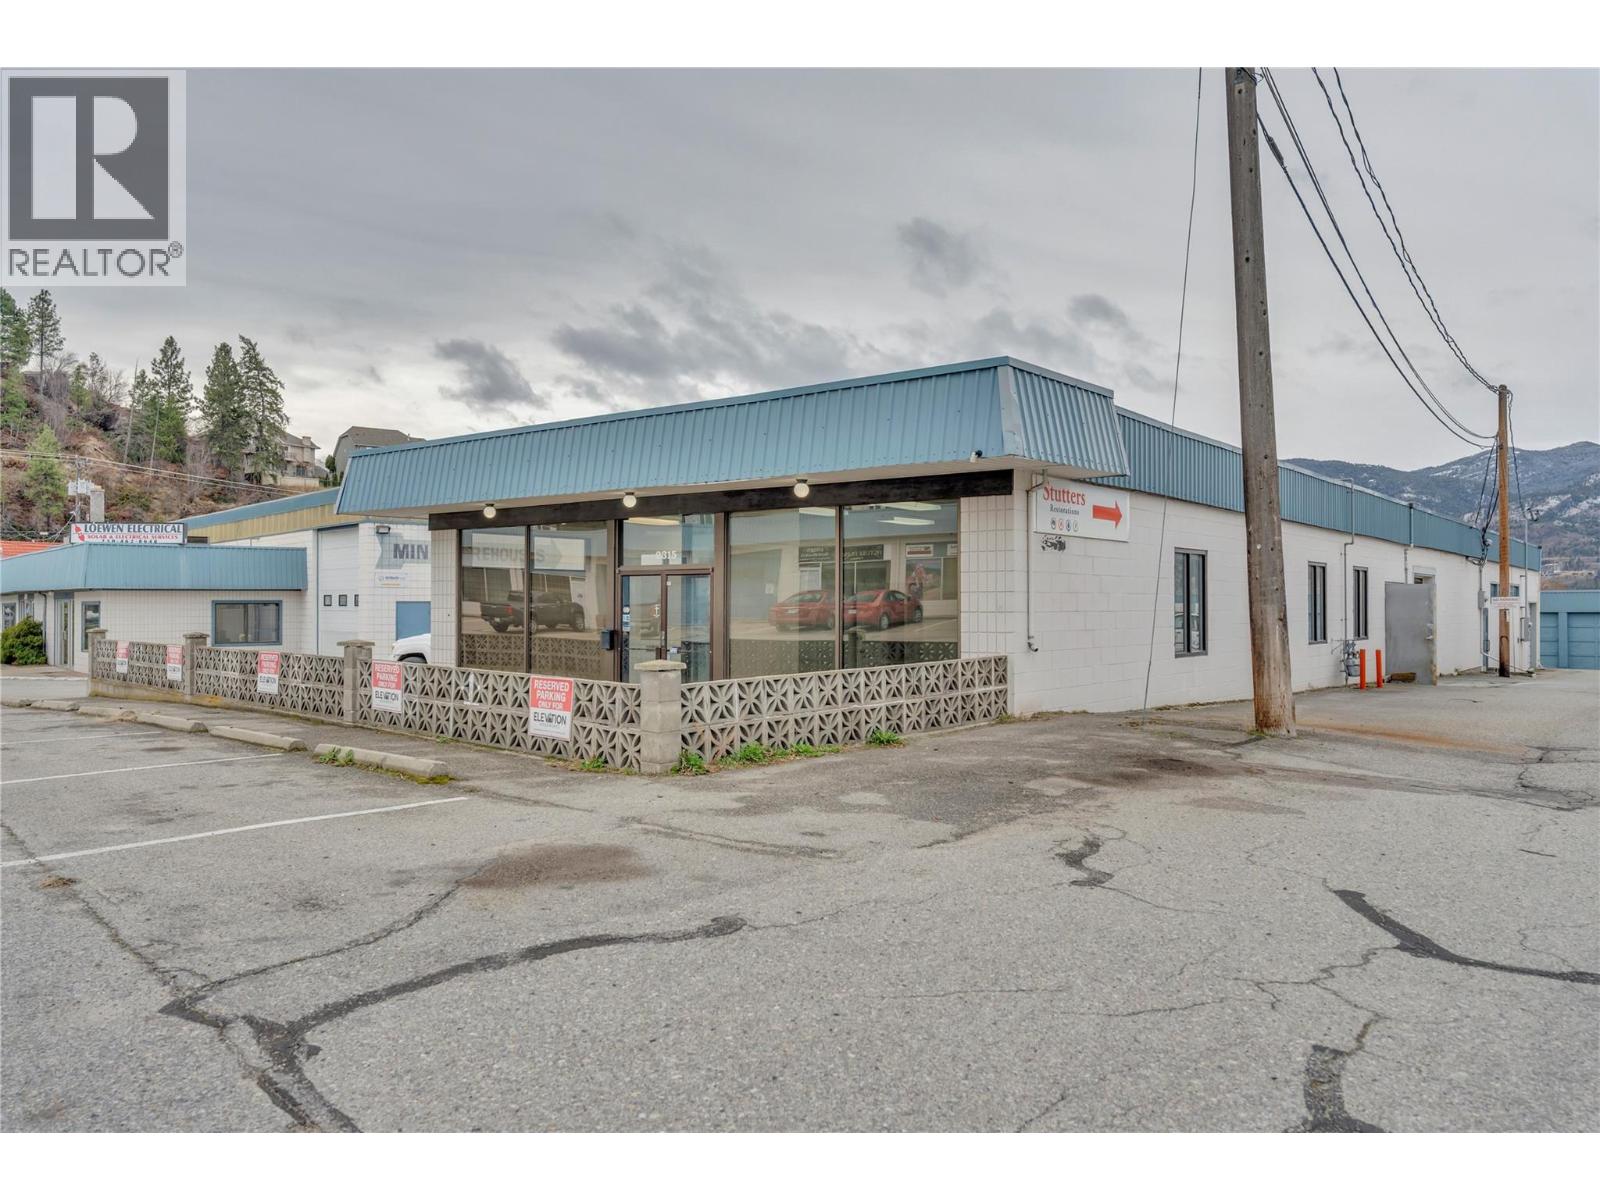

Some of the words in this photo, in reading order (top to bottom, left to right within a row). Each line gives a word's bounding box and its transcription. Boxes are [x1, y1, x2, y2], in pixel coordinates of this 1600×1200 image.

[1043, 485, 1086, 506] Stutters
[84, 524, 123, 533] LOEWEN
[127, 524, 182, 533] ELECTRICAL
[534, 680, 570, 692] RESERVED
[536, 690, 567, 702] PARKING
[538, 700, 551, 709] ONLY
[553, 702, 564, 710] FOR
